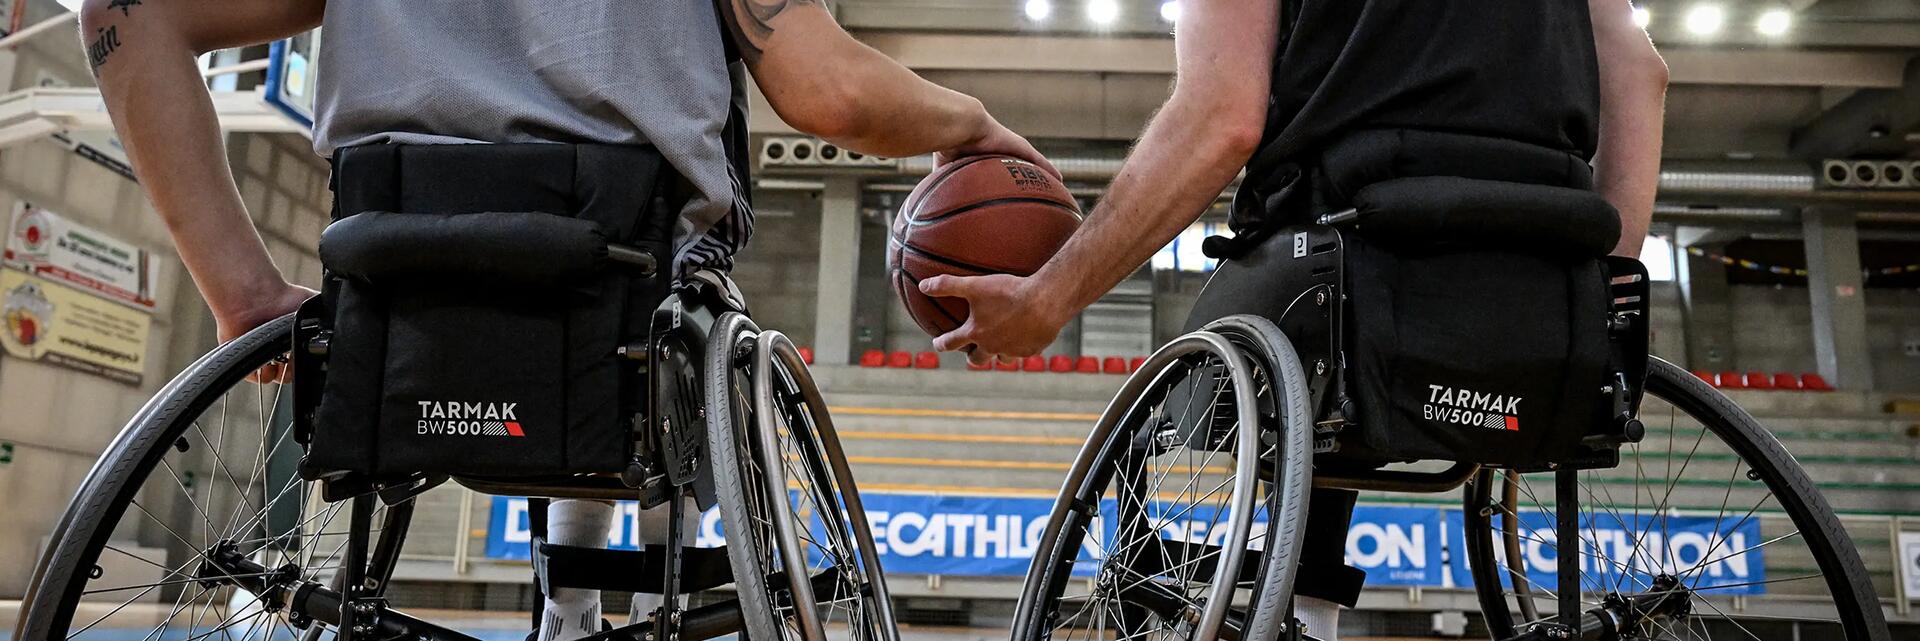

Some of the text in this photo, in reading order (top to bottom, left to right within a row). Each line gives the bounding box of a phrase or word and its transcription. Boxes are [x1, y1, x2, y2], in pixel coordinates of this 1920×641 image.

[418, 400, 517, 420] TARMAK
[1429, 384, 1522, 415] TARMAK
[1423, 404, 1484, 426] BW500
[417, 420, 482, 435] BW500
